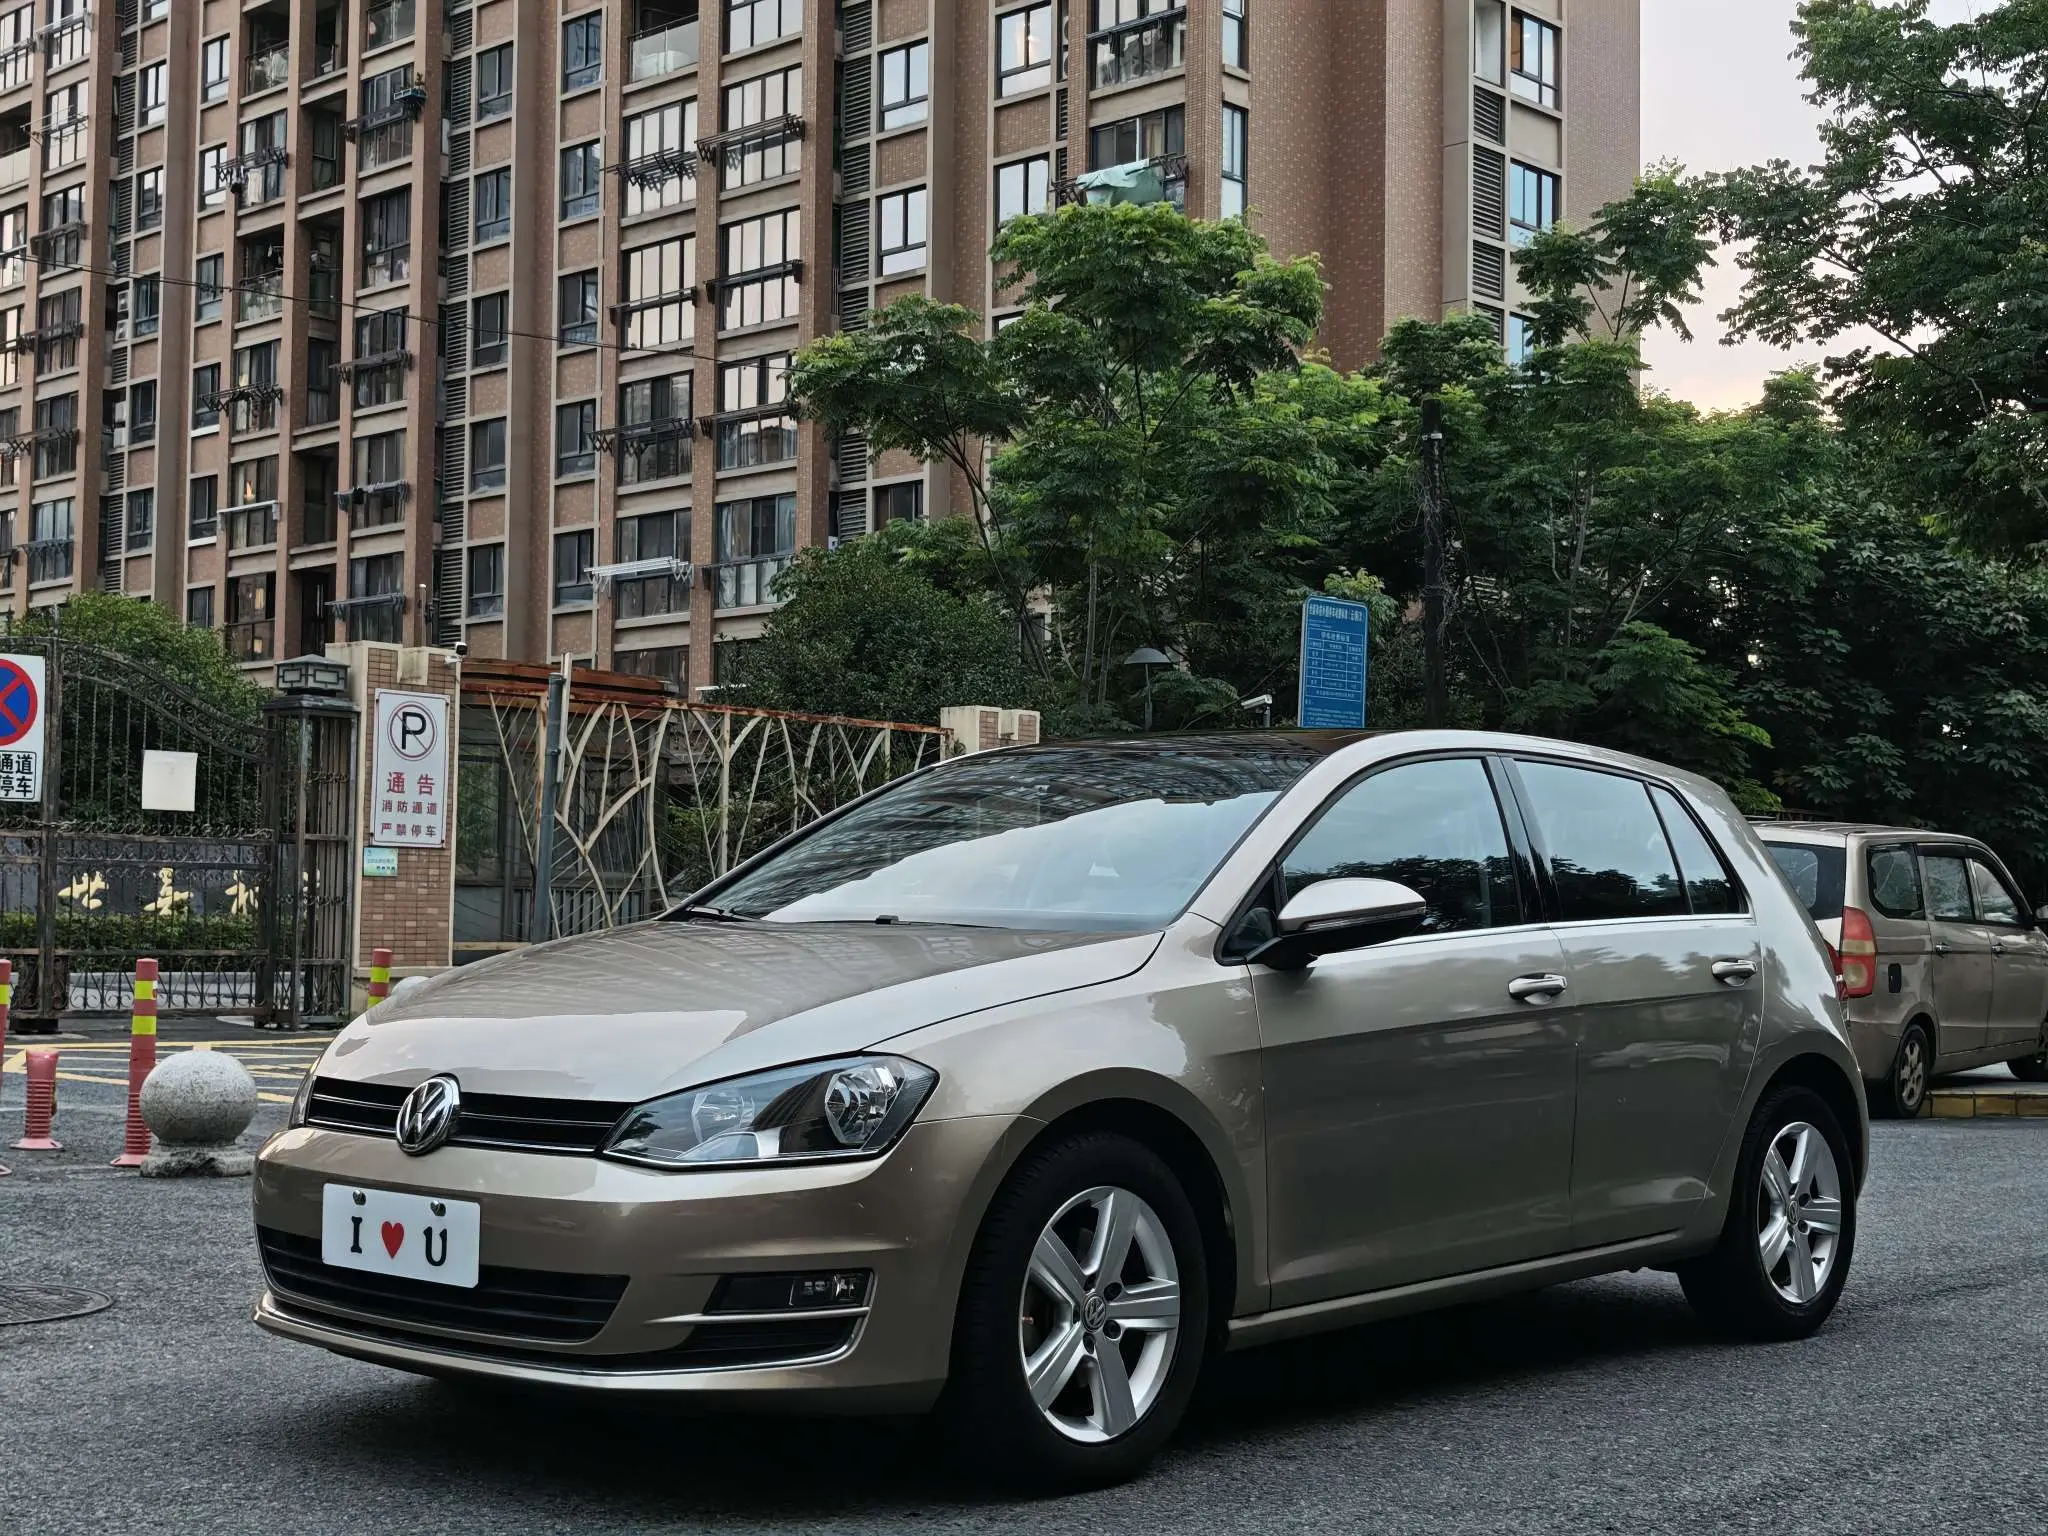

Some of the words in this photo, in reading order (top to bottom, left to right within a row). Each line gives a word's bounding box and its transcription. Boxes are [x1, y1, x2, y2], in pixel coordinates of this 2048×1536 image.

[386, 771, 436, 796] 通告
[382, 799, 438, 815] 消防通道
[351, 1216, 362, 1254] I
[423, 1226, 448, 1266] U
